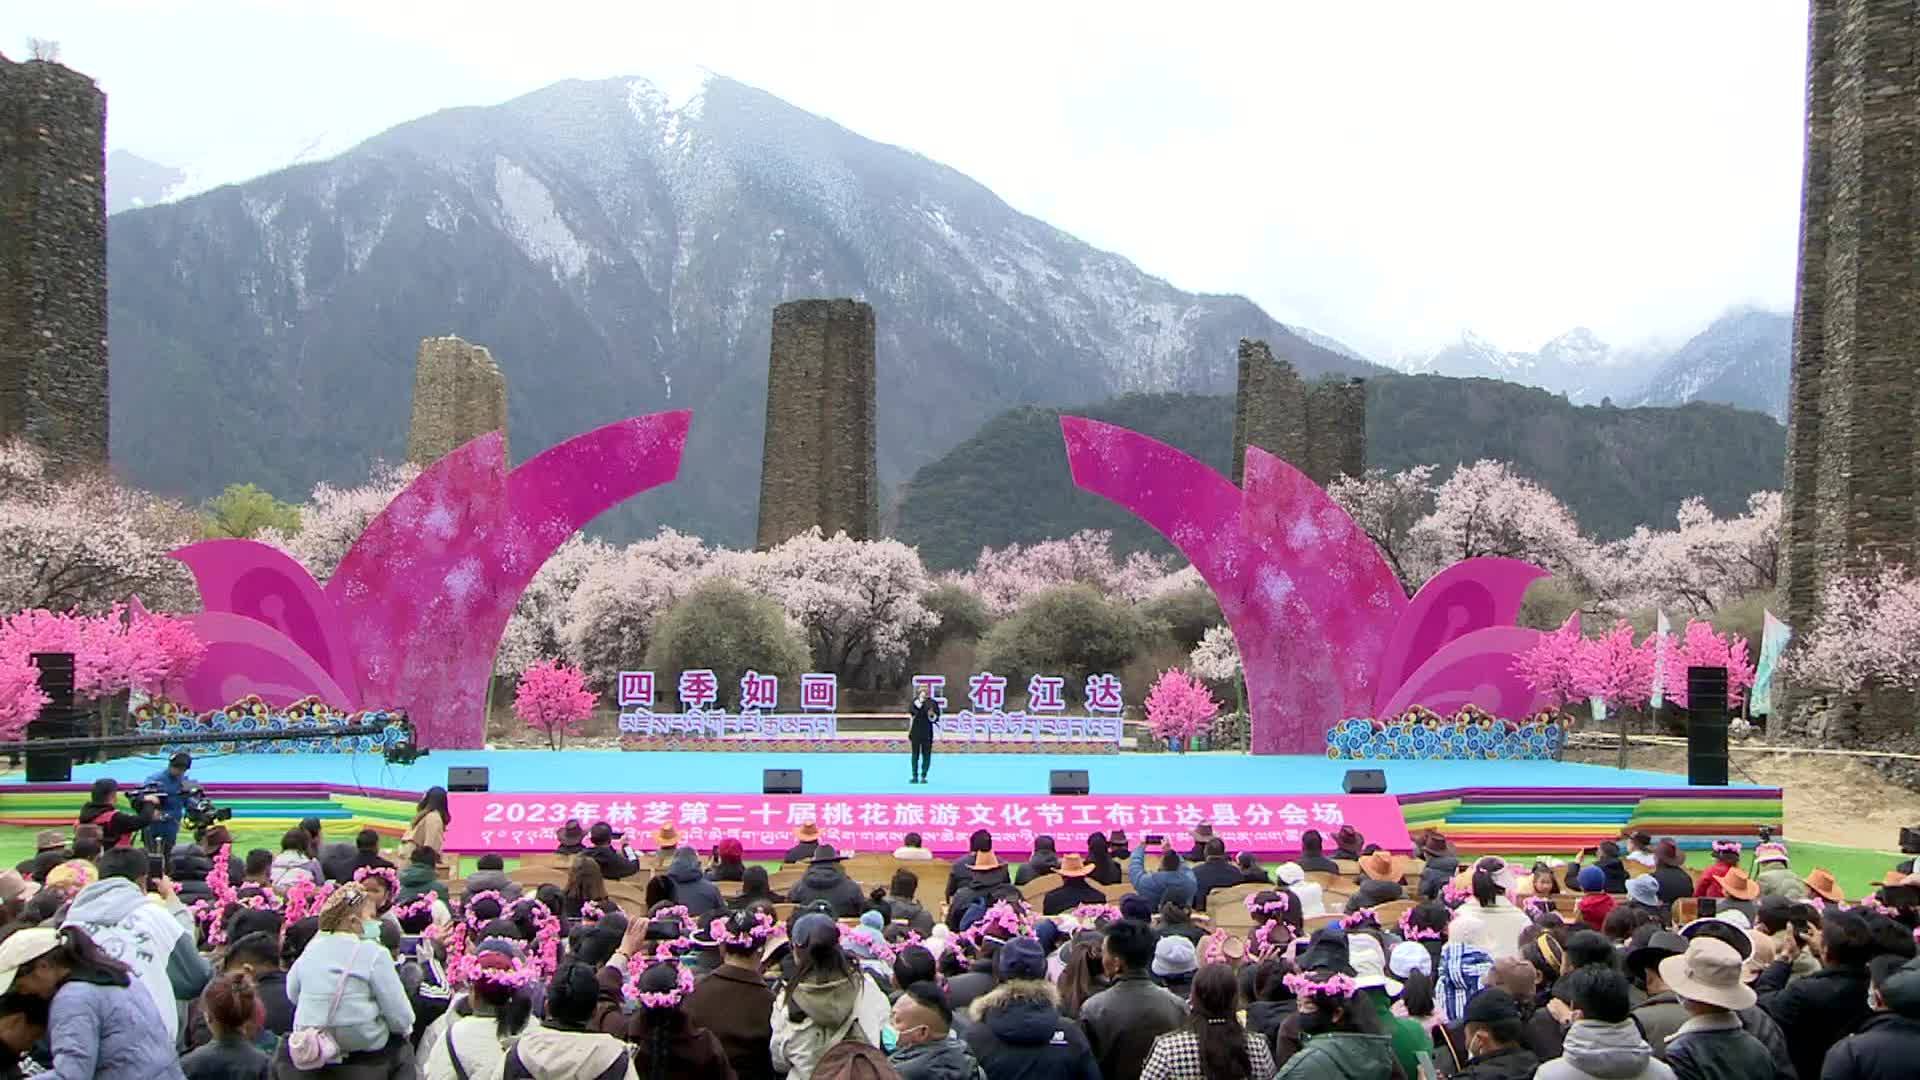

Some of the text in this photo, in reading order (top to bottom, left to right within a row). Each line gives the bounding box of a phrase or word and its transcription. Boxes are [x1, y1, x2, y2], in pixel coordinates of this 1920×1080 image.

[619, 671, 1121, 710] 四季如画 工布江达
